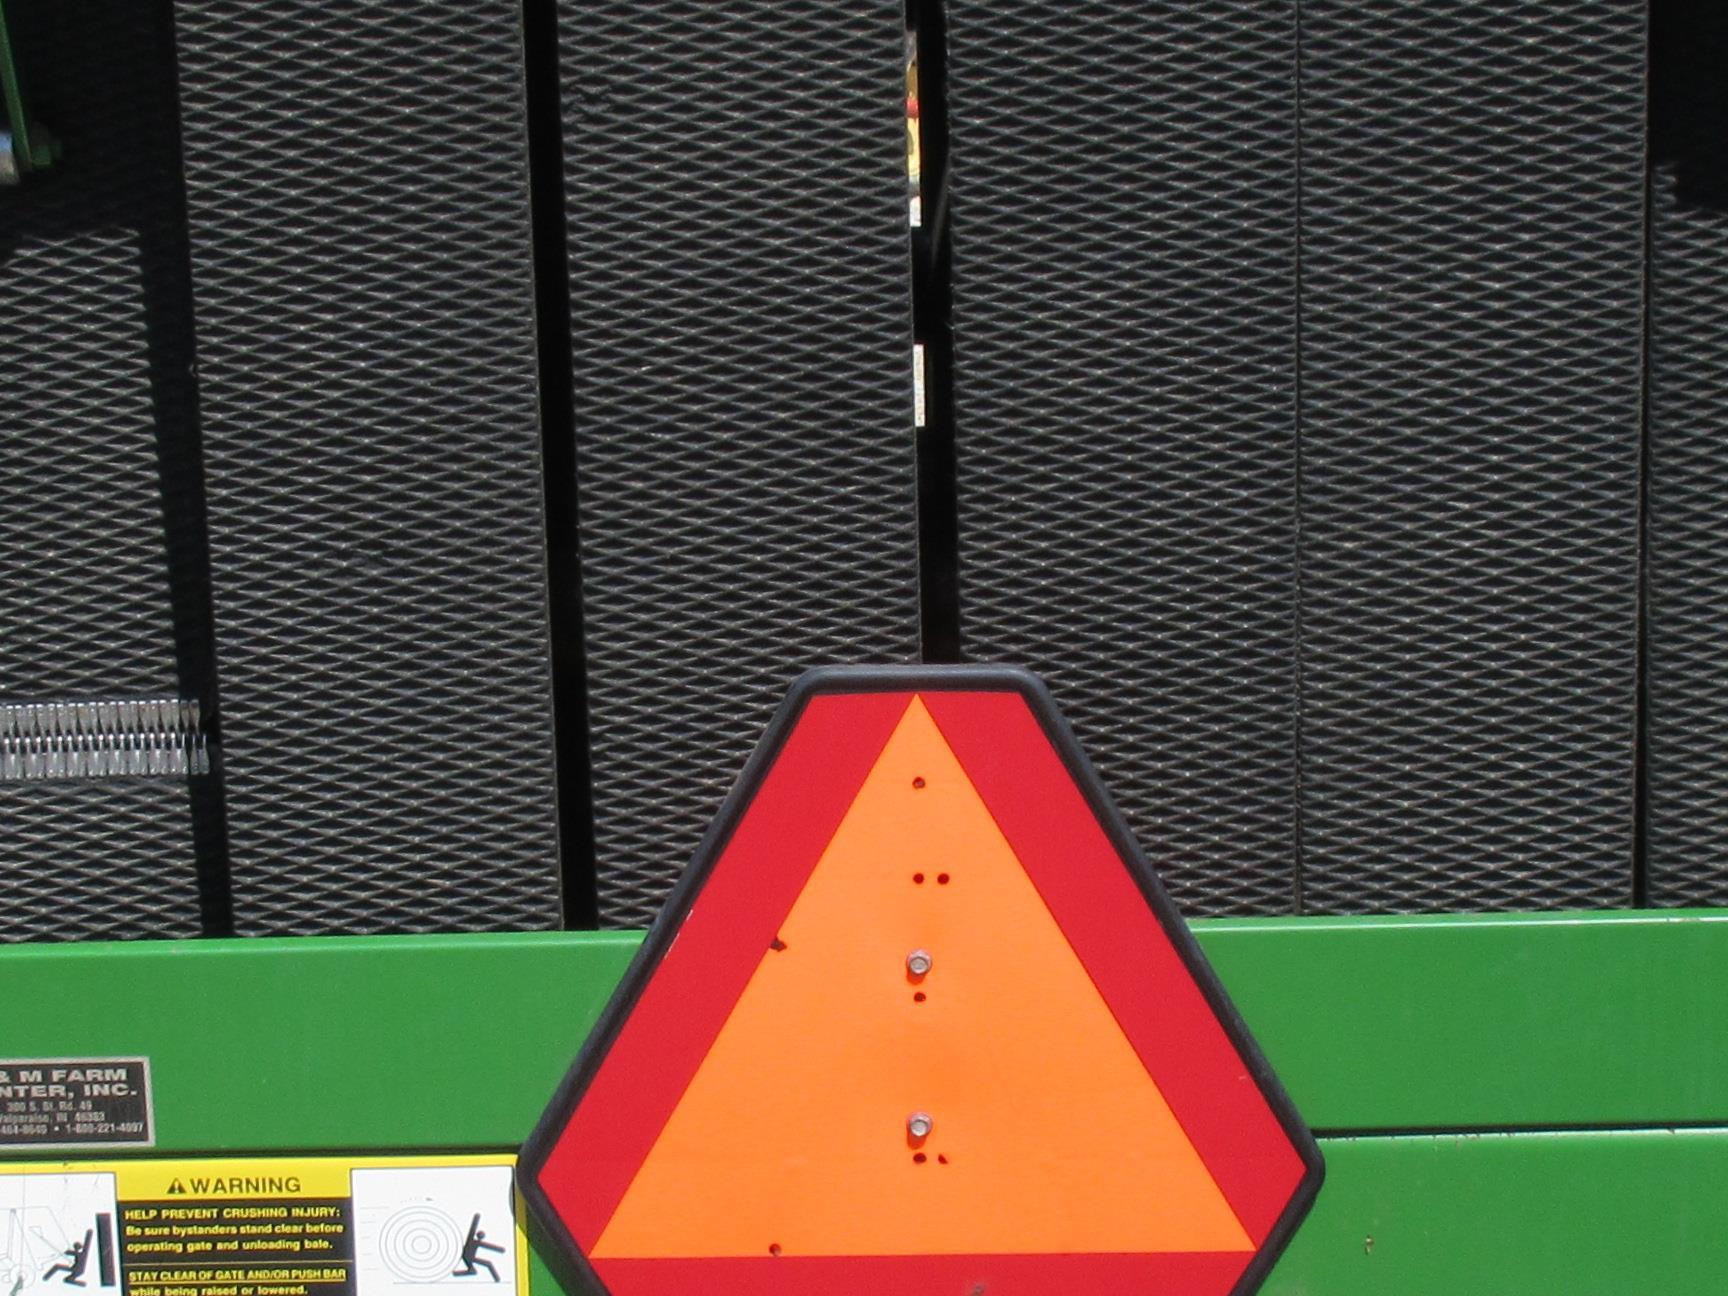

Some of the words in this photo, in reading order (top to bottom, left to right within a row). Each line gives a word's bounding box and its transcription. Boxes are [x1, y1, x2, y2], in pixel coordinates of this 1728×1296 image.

[19, 1070, 43, 1083] M
[52, 1069, 128, 1082] FARM
[84, 1082, 137, 1096] INC.
[190, 1177, 301, 1194] WARNING
[125, 1209, 157, 1220] HELP
[162, 1208, 218, 1219] PREVENT
[223, 1208, 287, 1219] CRUSHING
[292, 1207, 340, 1218] INJURY:
[126, 1226, 142, 1236] Be
[144, 1227, 169, 1236] sure
[173, 1225, 237, 1237] bystanders
[240, 1224, 272, 1235] stand
[275, 1224, 303, 1234] clear
[305, 1223, 343, 1234] before
[127, 1241, 183, 1253] operating
[187, 1241, 213, 1253] gate
[217, 1240, 238, 1251] and
[242, 1239, 300, 1252] unloading
[304, 1239, 333, 1249] bale.
[129, 1271, 158, 1282] STAY
[160, 1271, 197, 1281] CLEAR
[198, 1270, 214, 1281] OF
[215, 1270, 245, 1280] GATE
[247, 1269, 290, 1280] AND/OR
[291, 1269, 322, 1279] PUSH
[323, 1268, 346, 1279] BAR
[130, 1287, 160, 1296] while
[201, 1286, 237, 1296] raised
[241, 1287, 254, 1296] or
[258, 1285, 307, 1296] lowered.
